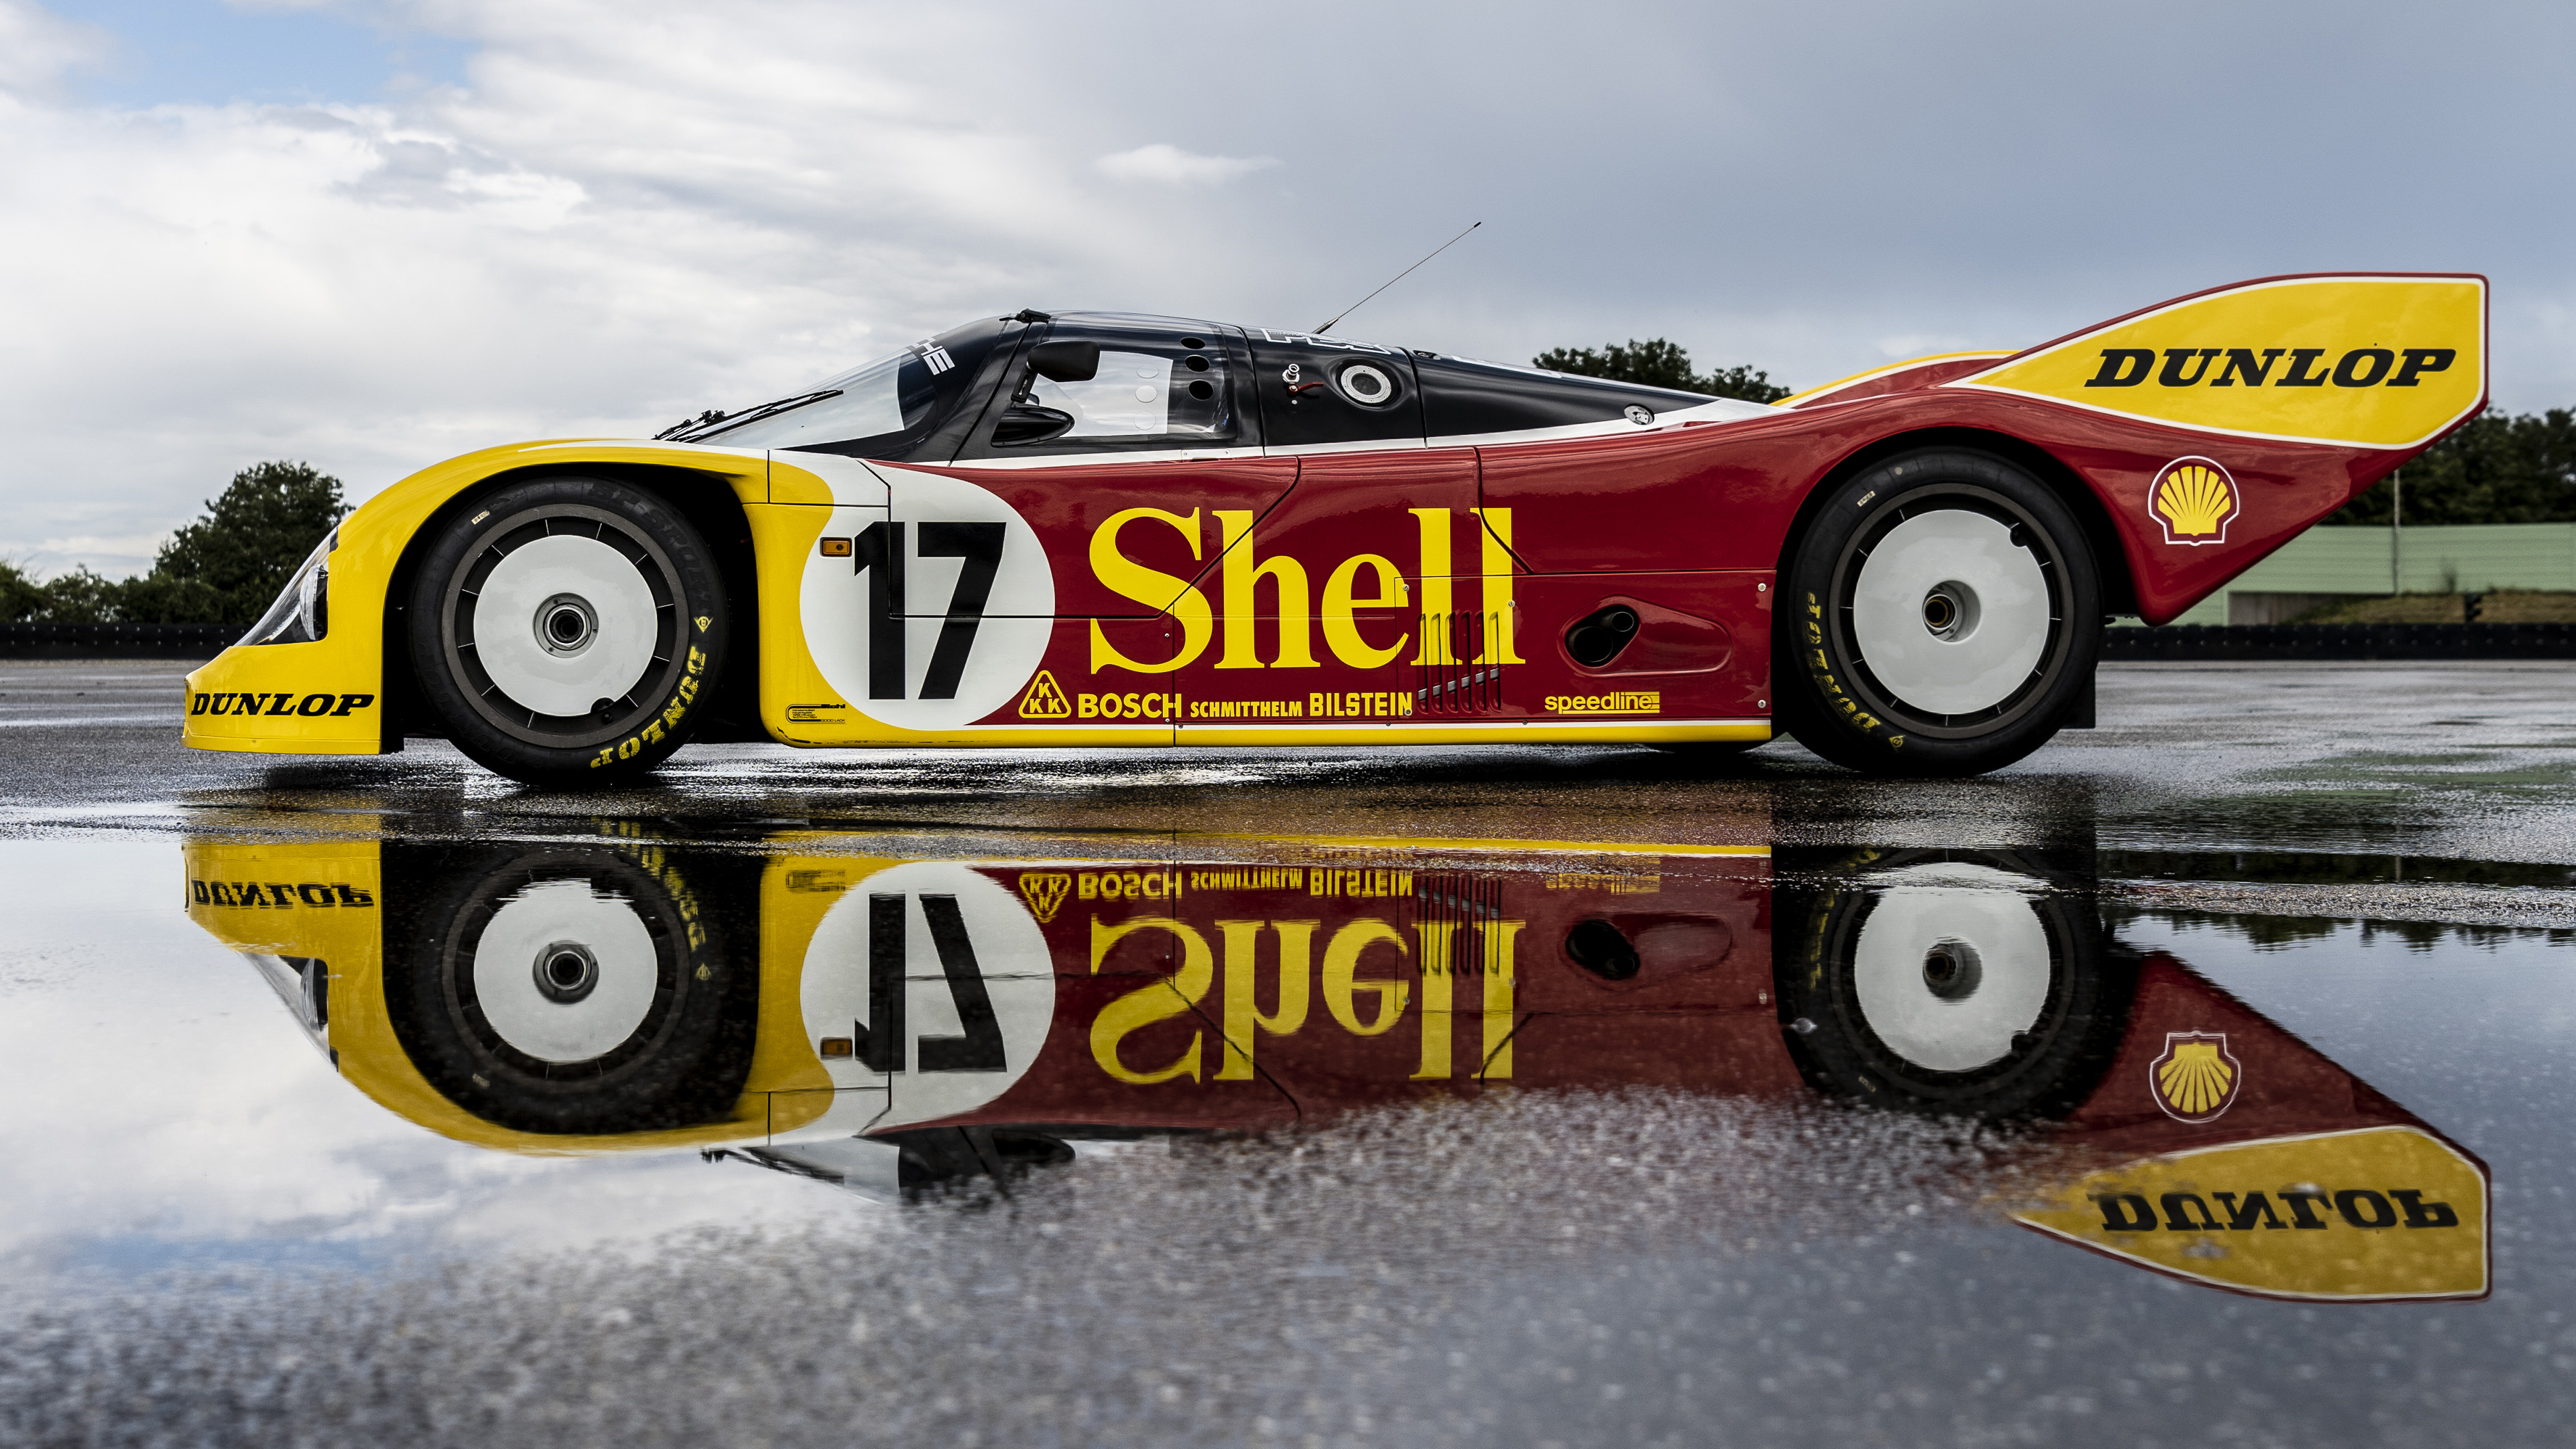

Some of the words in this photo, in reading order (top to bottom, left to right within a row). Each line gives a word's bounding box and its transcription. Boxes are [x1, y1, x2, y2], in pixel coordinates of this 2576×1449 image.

[2084, 349, 2456, 387] DUNLOP
[854, 521, 1007, 699] 17
[1089, 506, 1526, 675] Shell
[1805, 591, 1881, 734] DUNLOP
[191, 692, 375, 717] DUNLOP
[591, 645, 706, 768] DUNLOP
[1078, 692, 1182, 718] BOSCH
[1190, 701, 1303, 718] SCHMITTHELM
[1309, 692, 1412, 717] BILSTEIN
[1544, 692, 1660, 715] speedline
